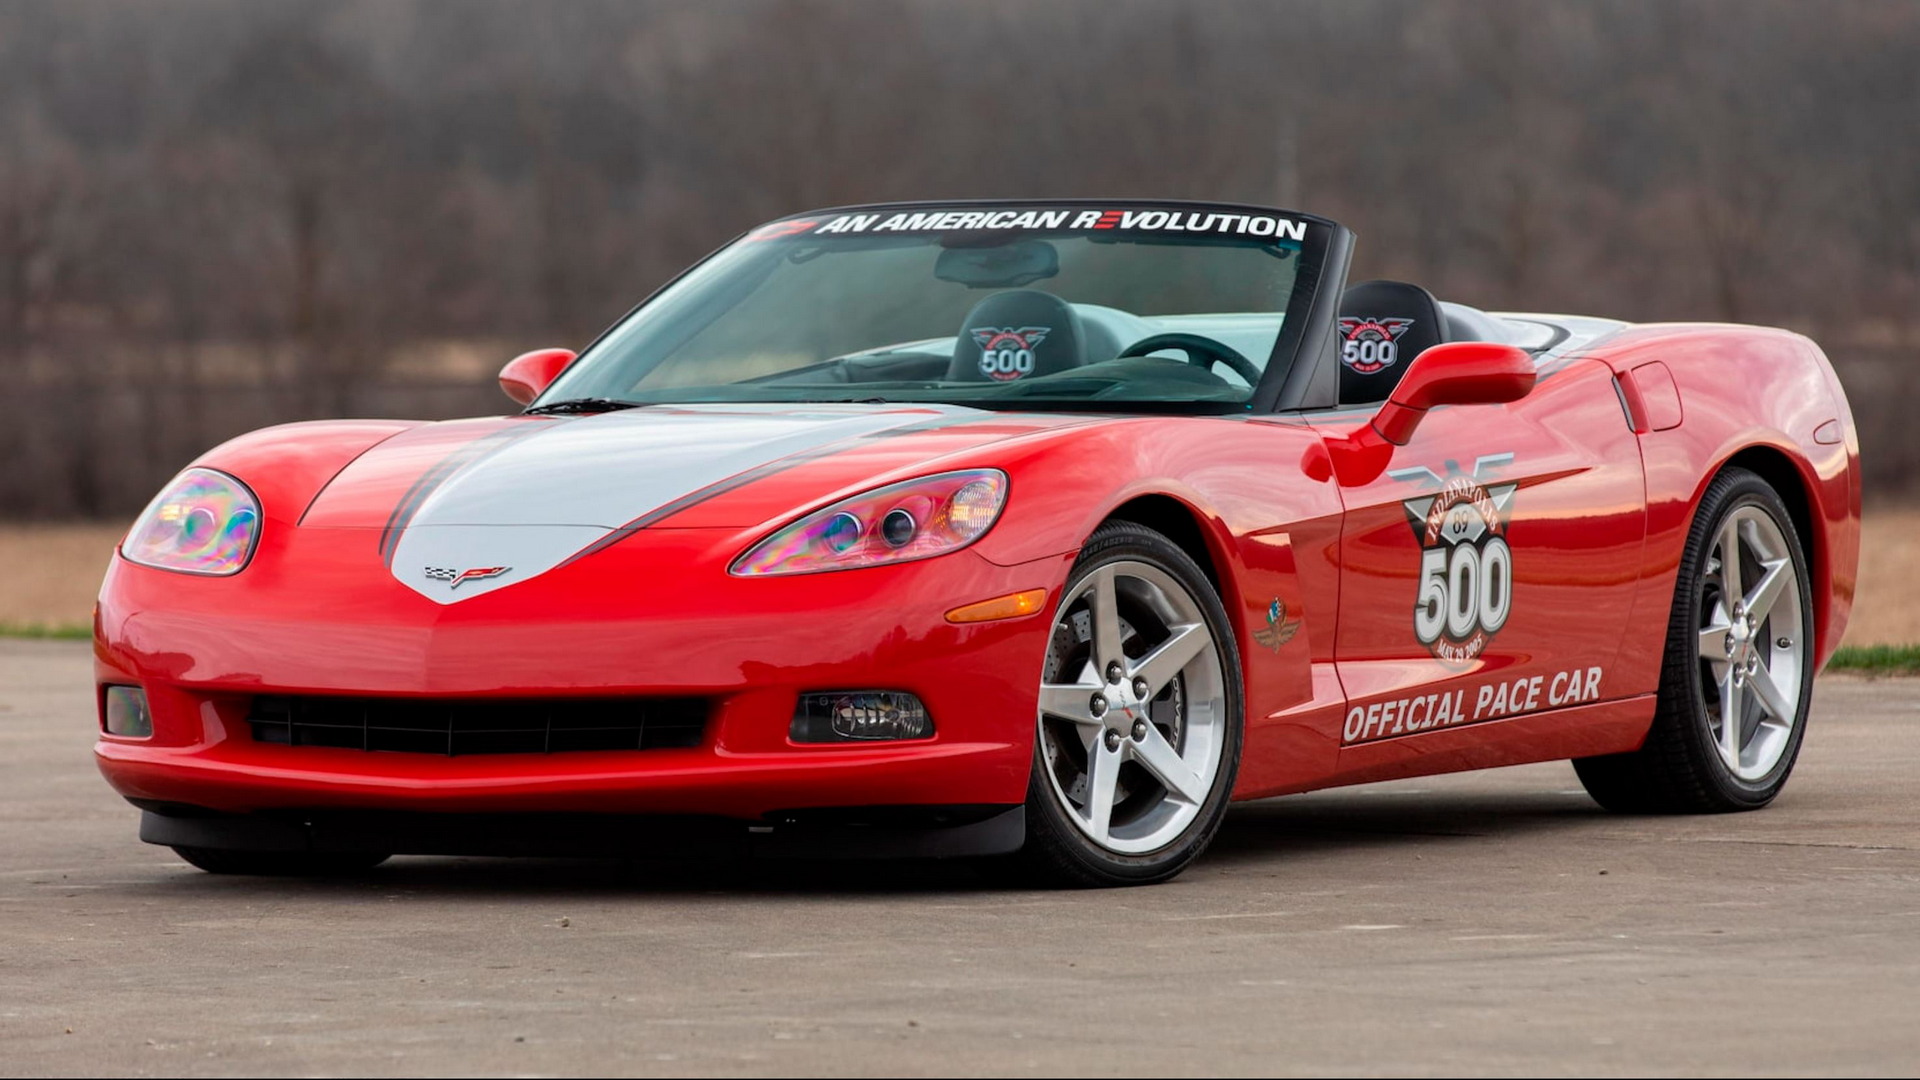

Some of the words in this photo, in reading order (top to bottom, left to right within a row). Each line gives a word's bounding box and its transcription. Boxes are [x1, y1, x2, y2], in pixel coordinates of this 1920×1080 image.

[815, 214, 879, 234] AN
[873, 211, 1068, 232] AMERICAN
[1069, 210, 1307, 242] REVOLUTION
[981, 349, 1033, 373] 500
[1342, 340, 1396, 364] 500
[1428, 480, 1498, 541] INDIANAPOLIS
[1453, 511, 1468, 534] 89
[1415, 537, 1512, 643] 500
[1437, 639, 1453, 661] MAY
[1343, 690, 1465, 742] OFFICIAL
[1473, 676, 1543, 719] PACE
[1548, 667, 1602, 705] CAR
